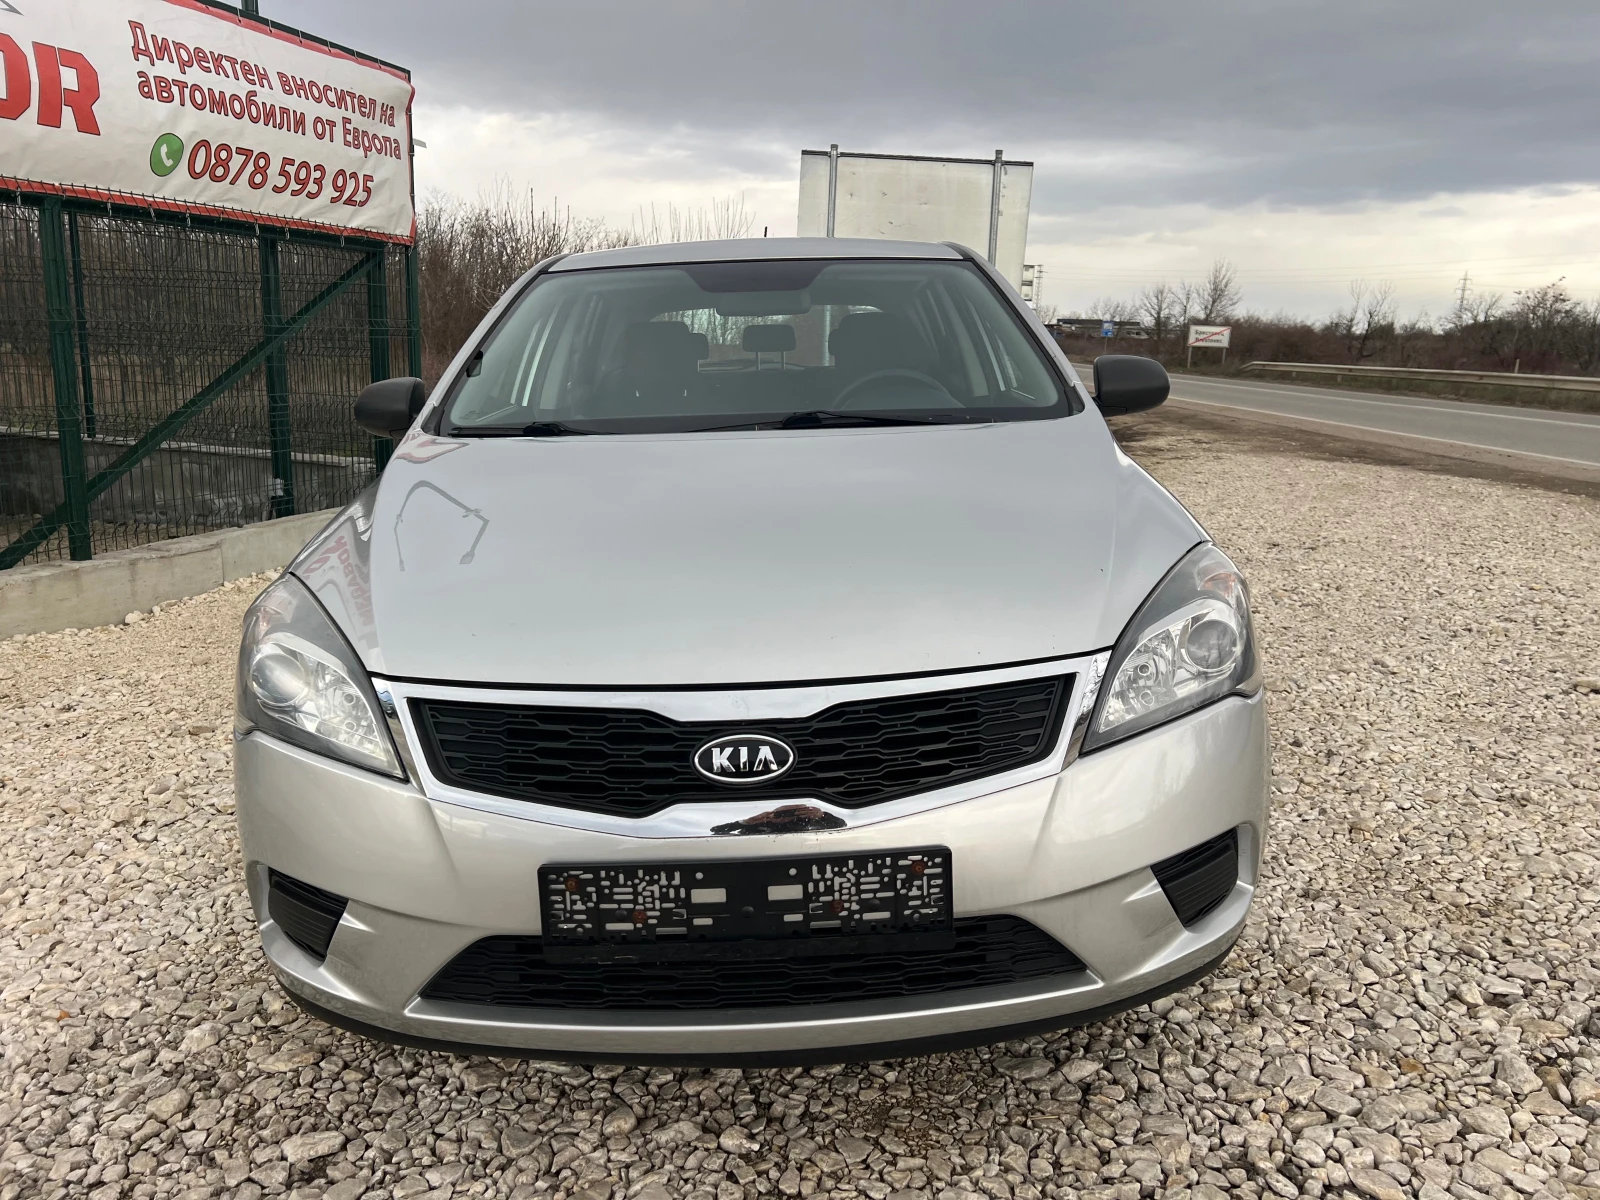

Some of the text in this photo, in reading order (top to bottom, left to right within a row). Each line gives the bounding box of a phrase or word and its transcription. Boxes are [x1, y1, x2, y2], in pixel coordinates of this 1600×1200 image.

[128, 20, 395, 128] Директен вносител на
[137, 71, 401, 160] автомобили от Европа
[187, 139, 375, 207] 0878 593 925
[710, 745, 779, 773] KIA
